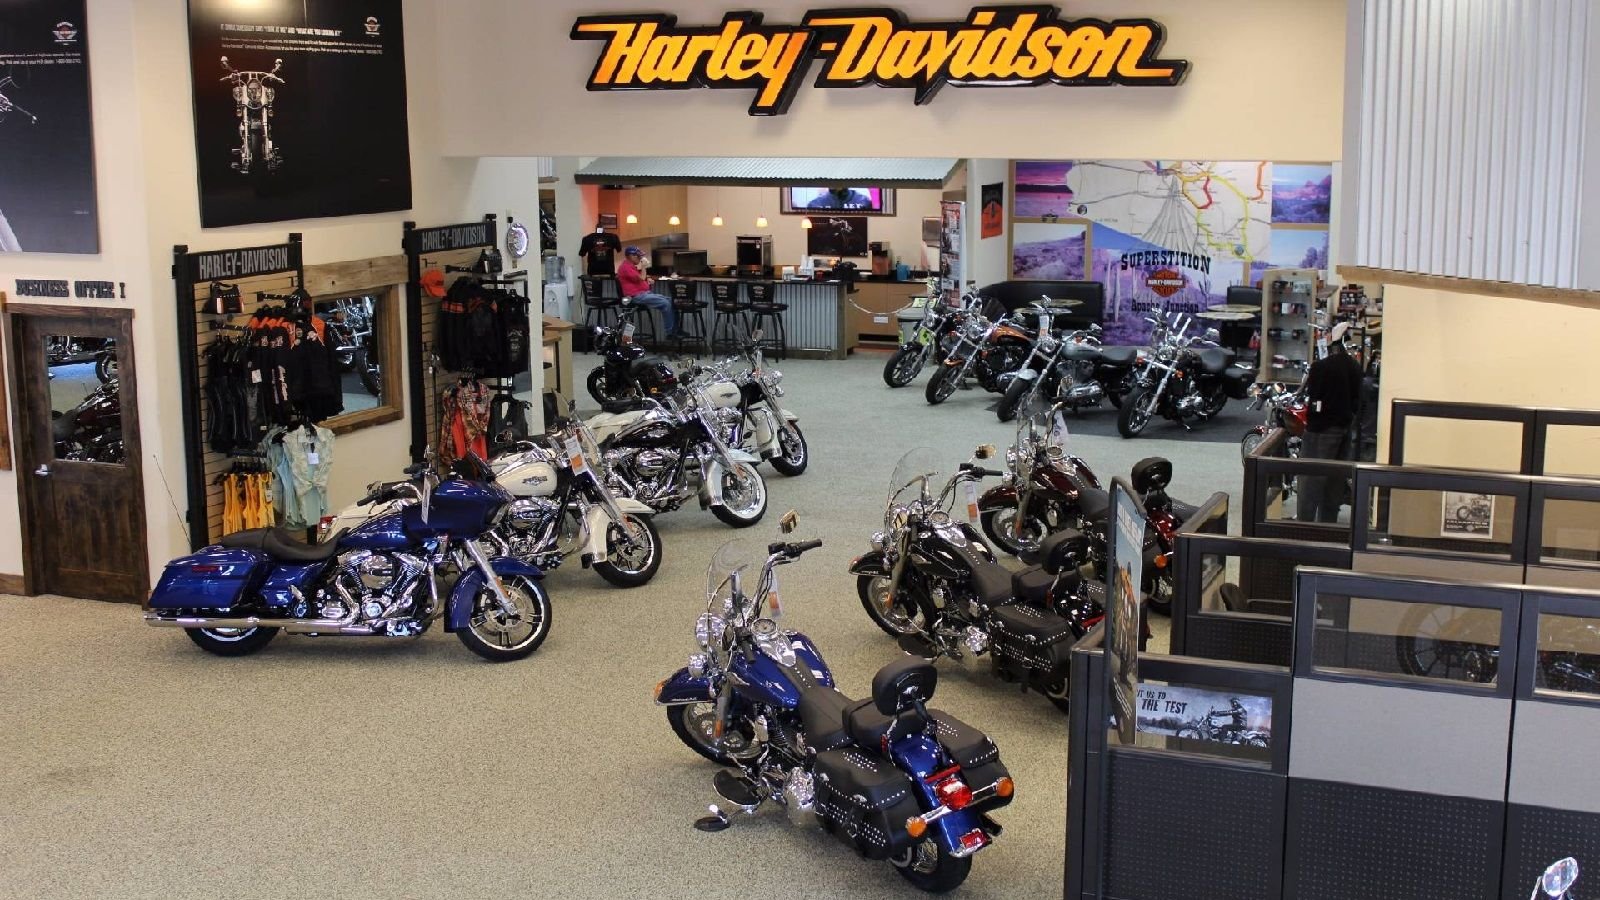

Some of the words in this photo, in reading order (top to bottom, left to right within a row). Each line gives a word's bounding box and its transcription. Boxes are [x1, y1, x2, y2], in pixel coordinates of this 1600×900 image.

[576, 10, 1178, 110] Harley-Davidson
[422, 224, 486, 250] HARLEY-DAVIDSON
[199, 247, 288, 280] HARLEY-DAVIDSON
[1121, 250, 1211, 275] SUPERSTITION
[15, 279, 69, 298] BUSINESS
[74, 280, 115, 298] OFFICE
[1164, 300, 1199, 313] Junction
[1157, 691, 1167, 700] TO
[1141, 699, 1159, 712] THE
[1165, 701, 1188, 715] TEST
